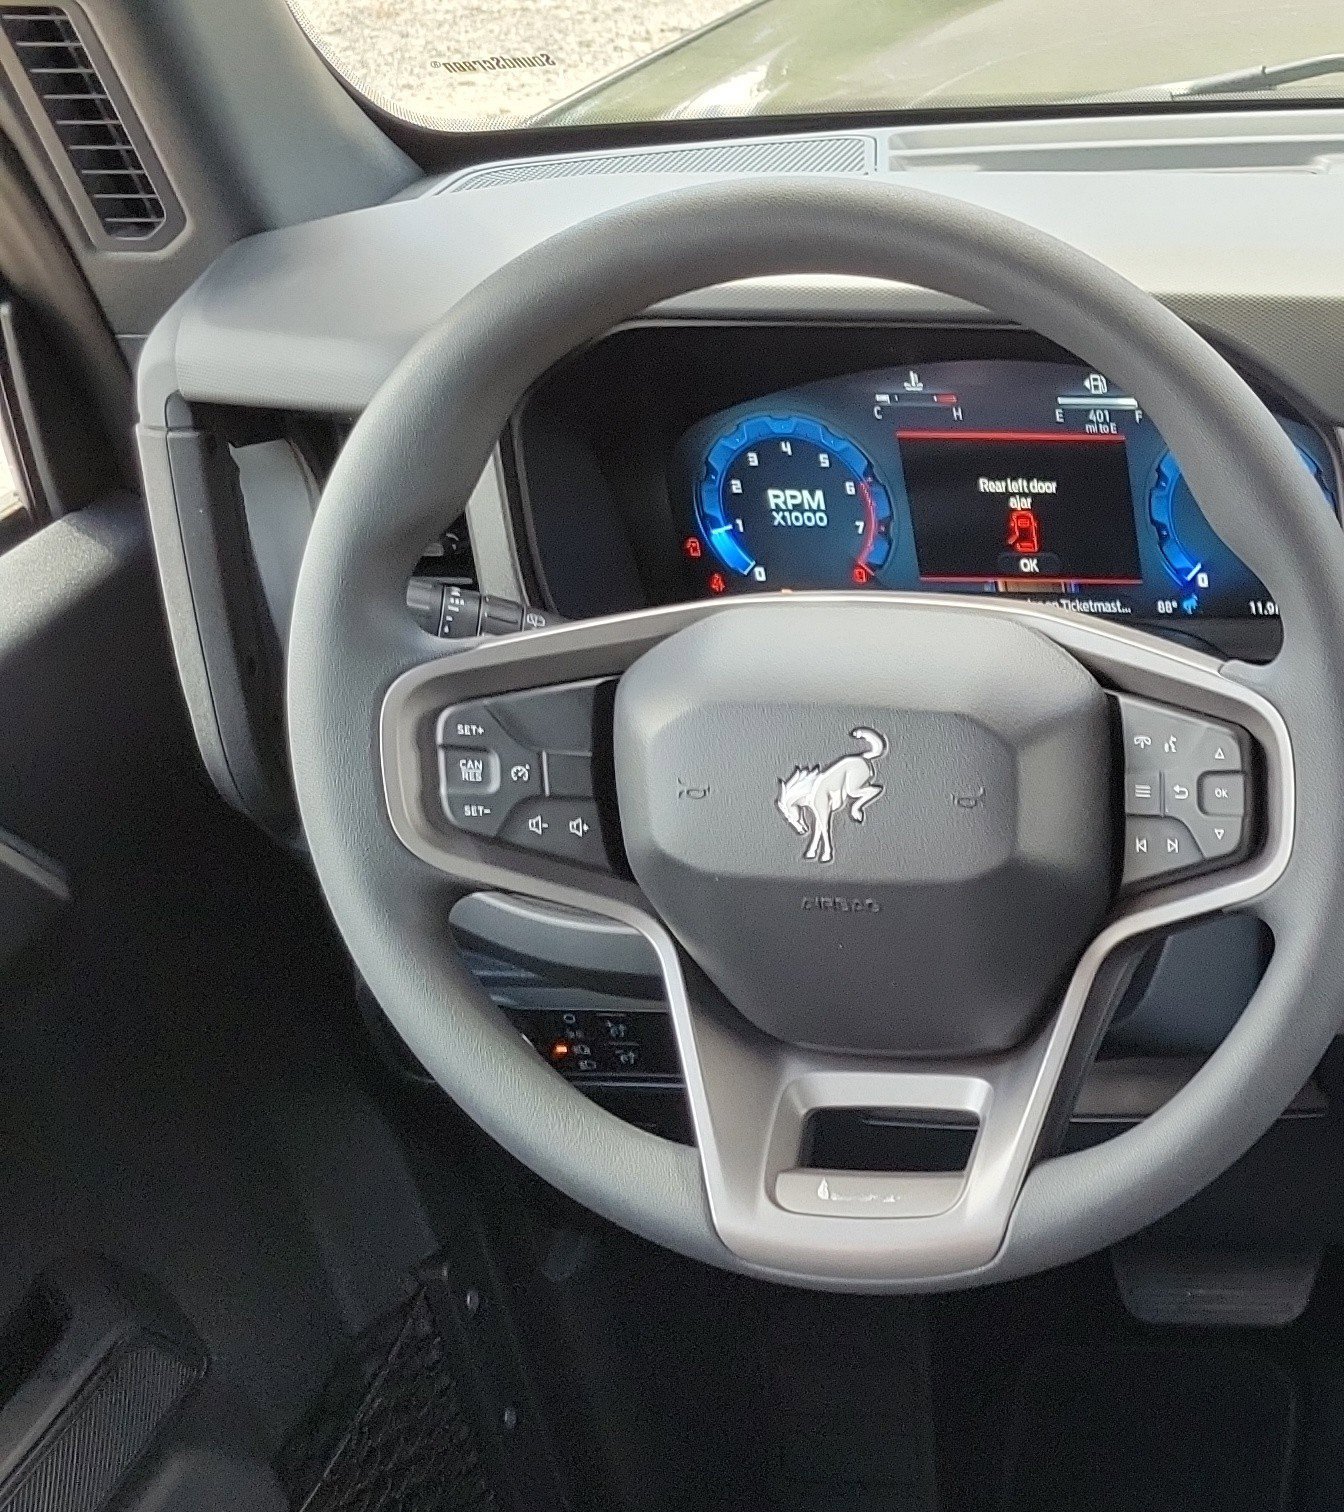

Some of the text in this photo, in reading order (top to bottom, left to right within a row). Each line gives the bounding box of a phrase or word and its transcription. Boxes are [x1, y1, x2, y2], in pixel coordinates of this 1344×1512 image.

[874, 406, 883, 420] C
[953, 407, 963, 421] H
[1055, 409, 1065, 423] E
[1088, 410, 1110, 423] 401
[1110, 424, 1117, 434] E
[781, 441, 792, 456] 4
[747, 452, 759, 467] 3
[819, 454, 830, 468] 5
[731, 479, 743, 494] 2
[844, 481, 856, 496] 6
[978, 477, 1057, 495] Rear left door
[767, 489, 827, 511] RPM
[1009, 495, 1033, 510] ajar
[736, 518, 744, 533] 1
[772, 511, 828, 527] X1000
[855, 520, 865, 535] 7
[1020, 558, 1040, 572] OK
[754, 566, 767, 582] 0
[1214, 788, 1229, 799] OK
